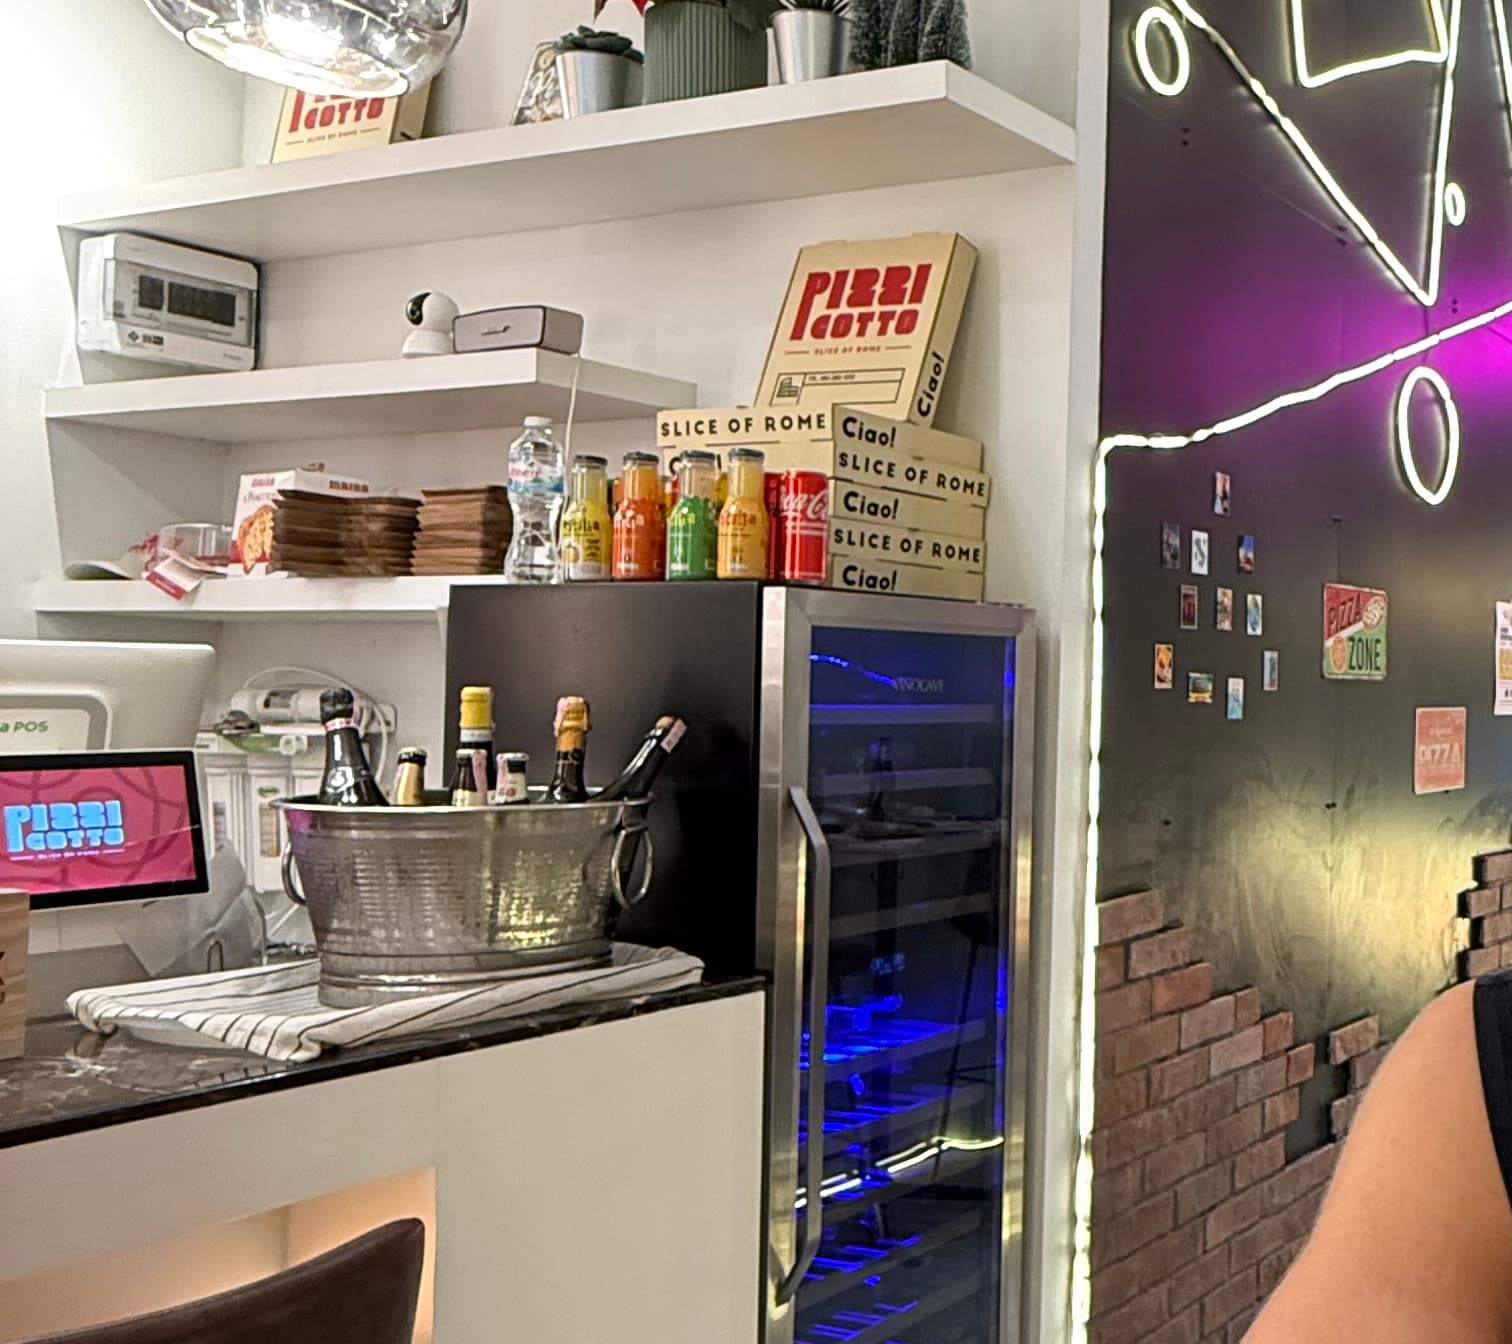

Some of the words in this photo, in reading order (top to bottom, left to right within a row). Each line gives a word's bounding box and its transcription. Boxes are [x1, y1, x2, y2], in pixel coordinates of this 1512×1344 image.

[810, 309, 920, 340] COTTO
[916, 350, 945, 417] Ciao!
[661, 419, 718, 437] SLICE
[728, 417, 753, 433] OF
[765, 413, 826, 432] ROME
[842, 415, 897, 448] Ciao!
[838, 452, 896, 478] SLICE
[905, 466, 928, 484] OF
[936, 473, 985, 497] ROME
[843, 490, 899, 519] Ciao!
[834, 528, 891, 551] SLICE
[900, 538, 923, 555] OF
[932, 542, 981, 563] ROME
[842, 564, 898, 591] Ciao!
[1327, 592, 1363, 638] PIZZA
[1346, 636, 1382, 672] ZONE
[13, 720, 49, 733] POS
[25, 827, 125, 852] COTTO
